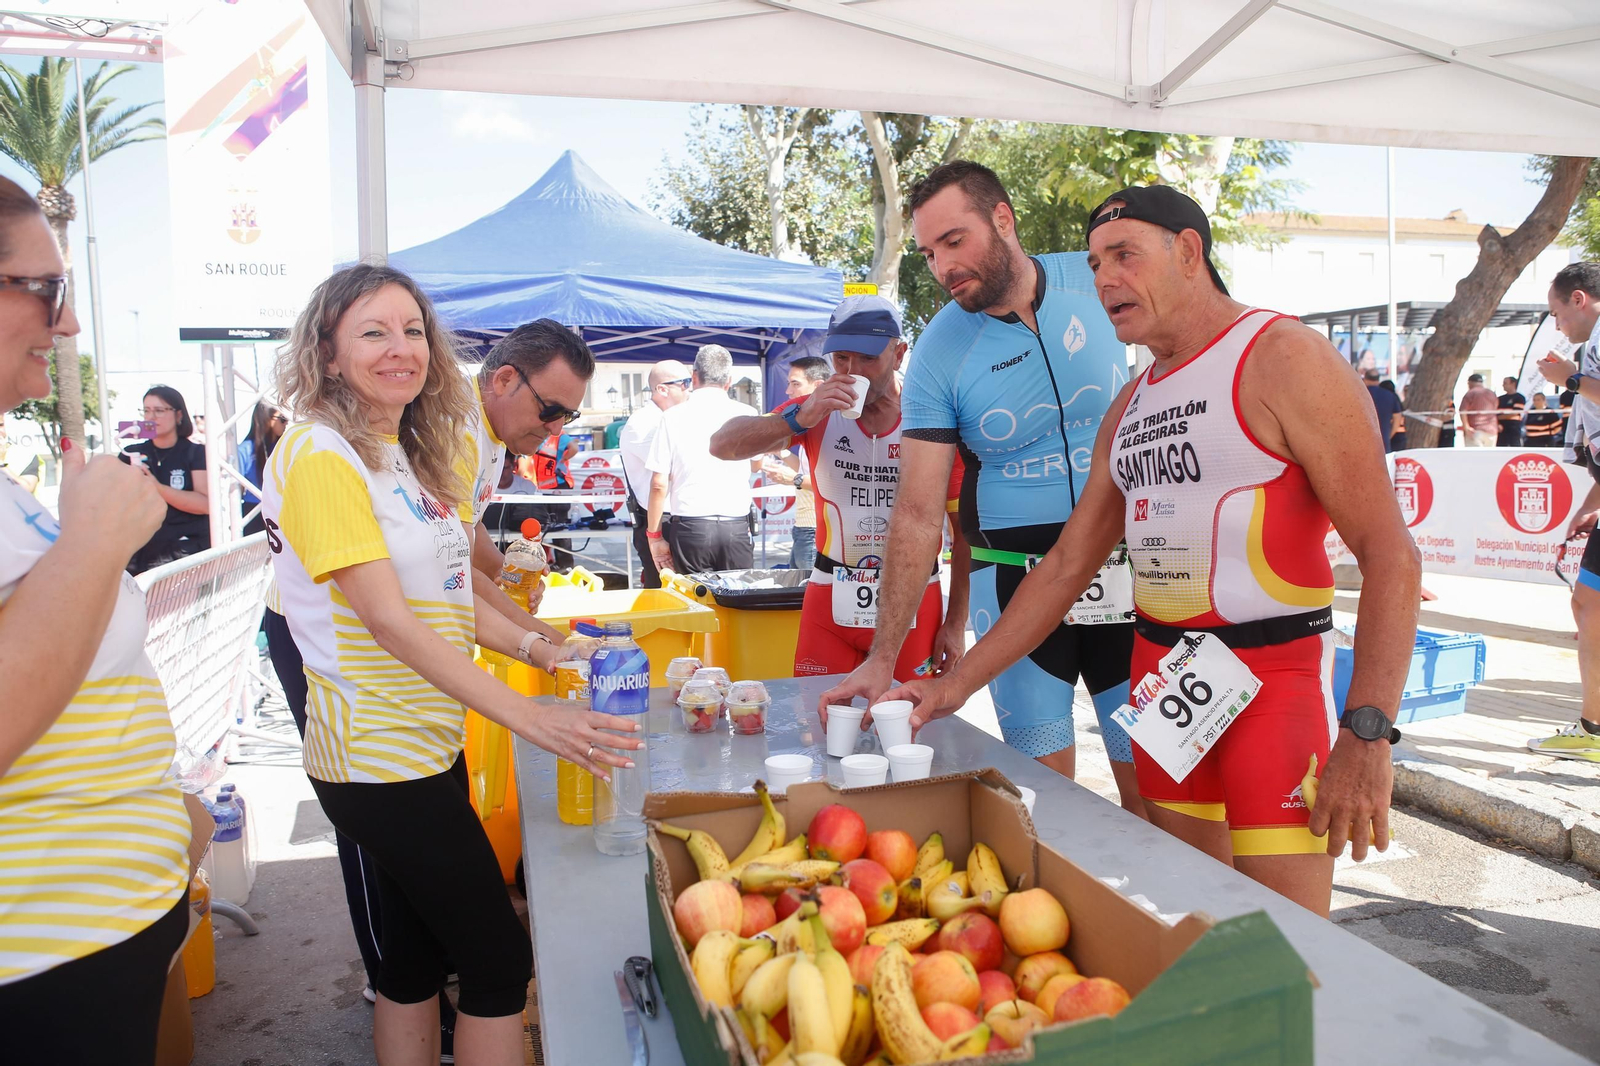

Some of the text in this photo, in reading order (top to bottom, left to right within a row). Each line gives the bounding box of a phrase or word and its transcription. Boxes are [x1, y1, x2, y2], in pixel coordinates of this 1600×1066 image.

[205, 263, 287, 276] SAN ROQUE
[991, 355, 1023, 373] FLOWER
[1118, 420, 1140, 438] CLUB
[1143, 400, 1207, 429] TRIATLÓN
[1119, 420, 1188, 451] ALGECIRAS
[834, 459, 860, 471] CLUB
[1117, 442, 1201, 492] SANTIAGO
[850, 486, 894, 508] FELIPE
[1417, 536, 1454, 549] de Deportes
[1476, 538, 1514, 551] Delegación
[1515, 540, 1549, 554] Municipal
[1423, 552, 1456, 564] San Roque
[1474, 555, 1495, 566] Ilustre
[1497, 556, 1543, 570] Ayuntamiento
[592, 672, 649, 691] AQUARIUS
[1159, 672, 1213, 728] 96
[1178, 687, 1234, 749] SANTIAGO ASENCIO PERALTA
[1203, 726, 1218, 743] PST
